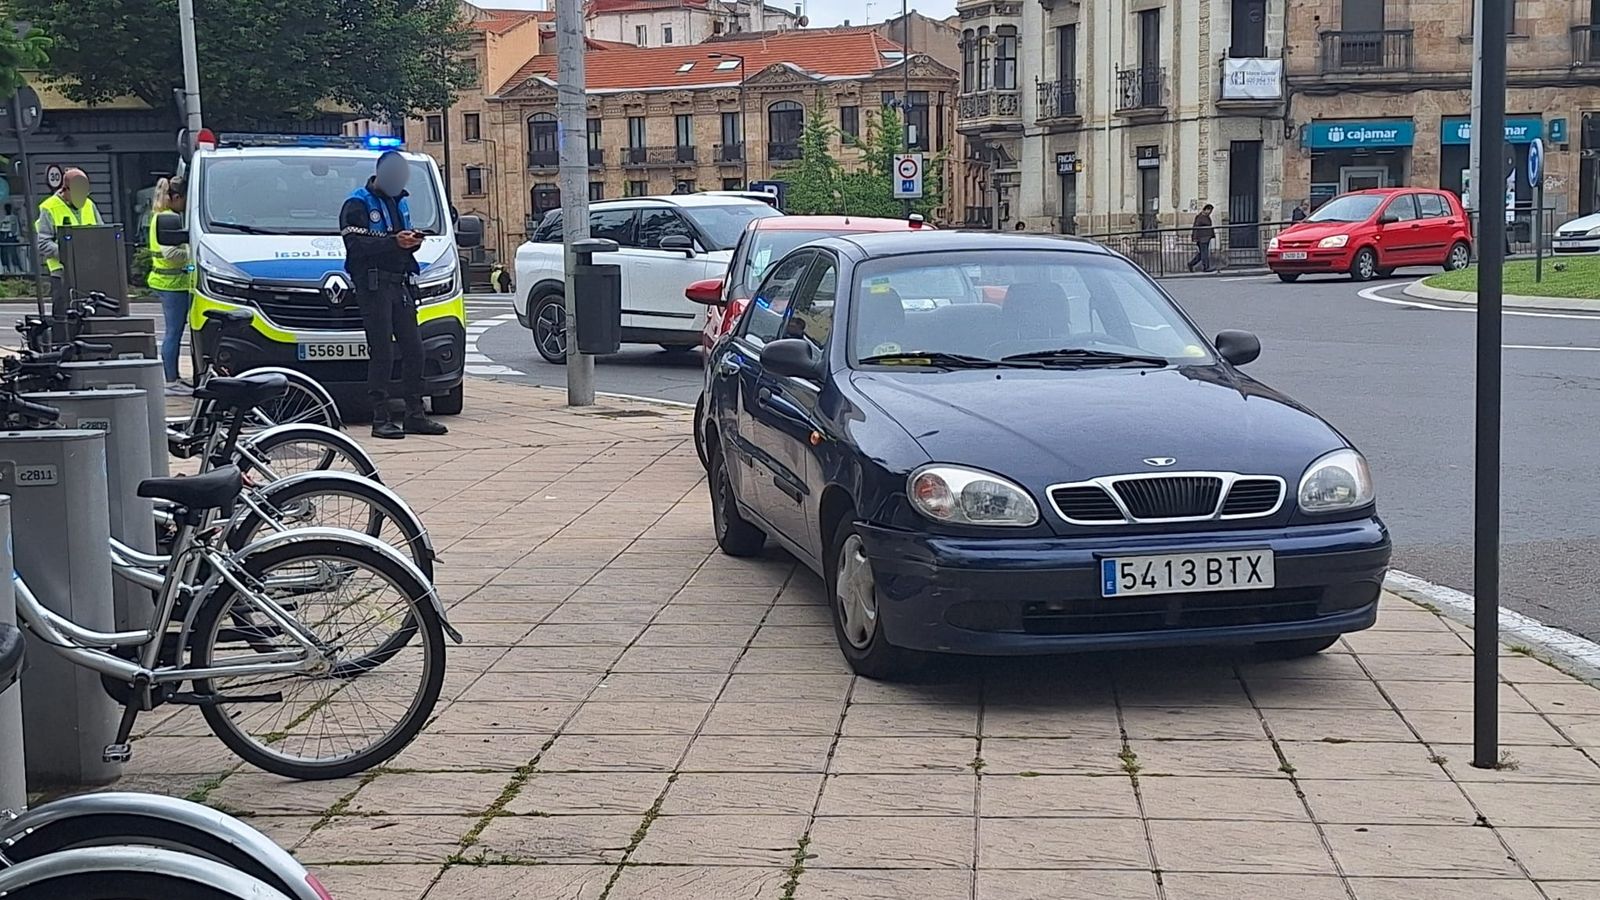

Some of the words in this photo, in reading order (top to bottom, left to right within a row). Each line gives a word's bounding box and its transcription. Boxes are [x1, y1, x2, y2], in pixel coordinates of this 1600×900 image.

[1347, 127, 1398, 142] cajamar
[50, 172, 60, 181] 30
[308, 344, 344, 357] 5569
[349, 344, 371, 357] LR
[80, 421, 108, 430] c2809
[20, 470, 53, 481] c2811
[1106, 581, 1114, 590] E
[1120, 559, 1197, 590] 5413
[1206, 555, 1263, 586] BTX
